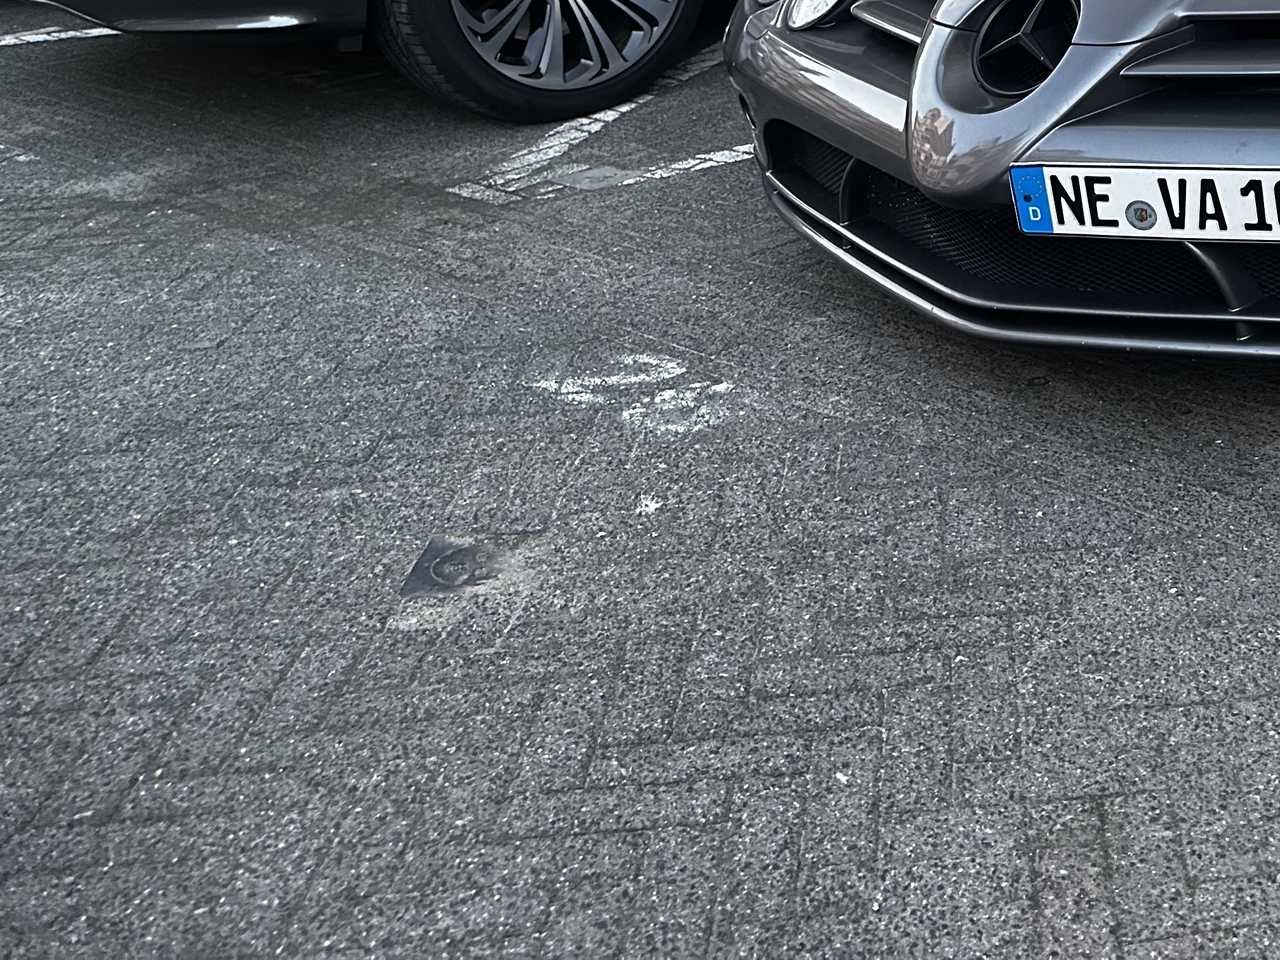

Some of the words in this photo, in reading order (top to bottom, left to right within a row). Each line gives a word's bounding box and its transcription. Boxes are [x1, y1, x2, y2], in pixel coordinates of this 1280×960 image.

[1028, 206, 1042, 221] D
[1049, 175, 1119, 227] NE
[1157, 178, 1228, 230] VA
